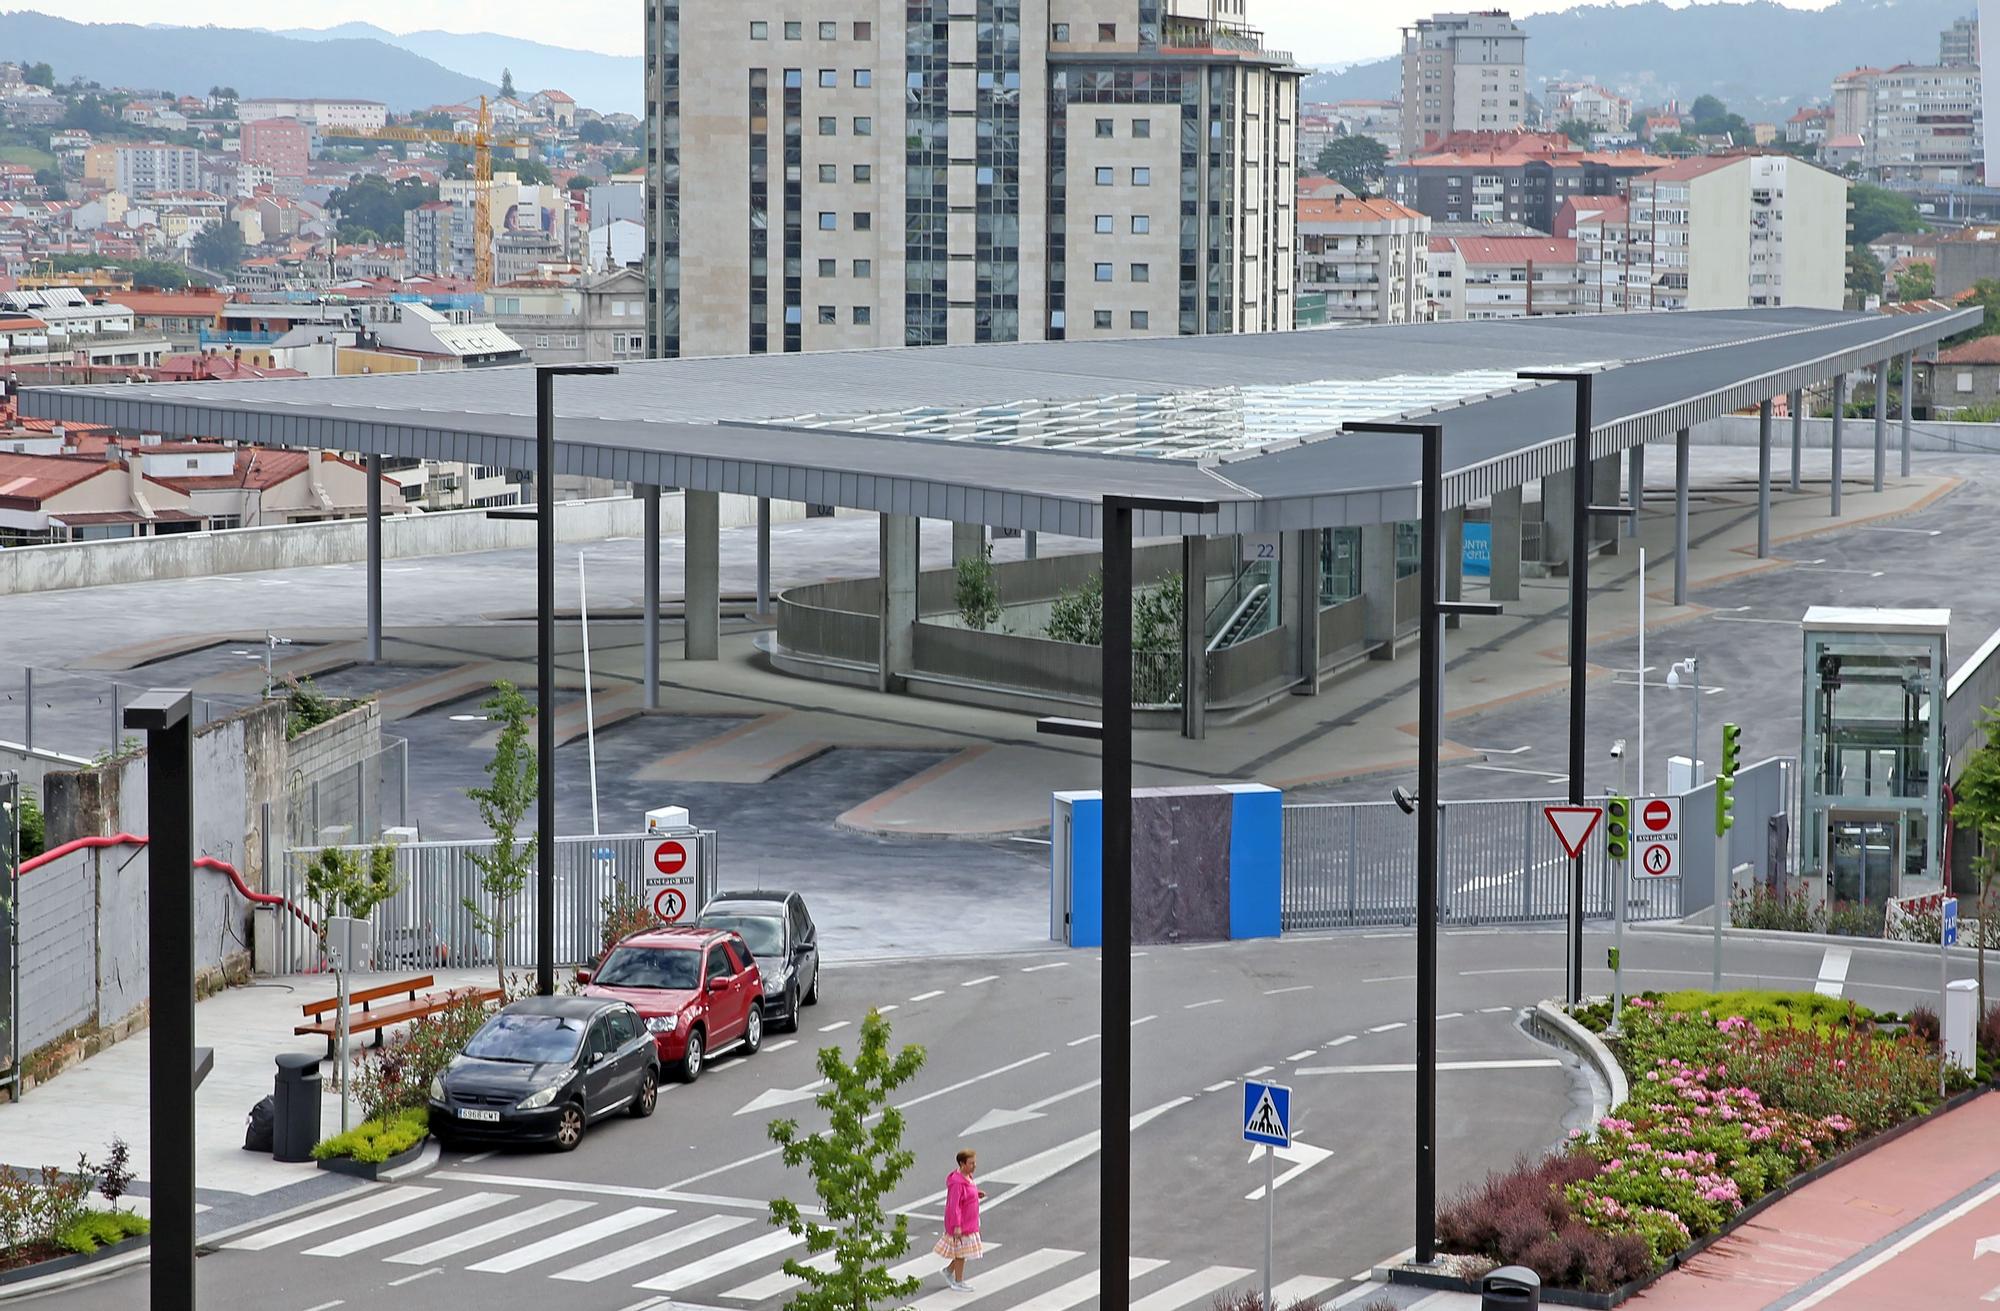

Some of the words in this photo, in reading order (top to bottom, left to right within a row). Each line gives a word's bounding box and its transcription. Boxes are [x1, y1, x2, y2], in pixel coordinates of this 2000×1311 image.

[515, 470, 530, 482] 04
[1257, 543, 1274, 558] 22
[1636, 834, 1663, 842] EXCEPTO
[646, 877, 677, 886] EXCEPTO
[679, 876, 695, 885] BUS
